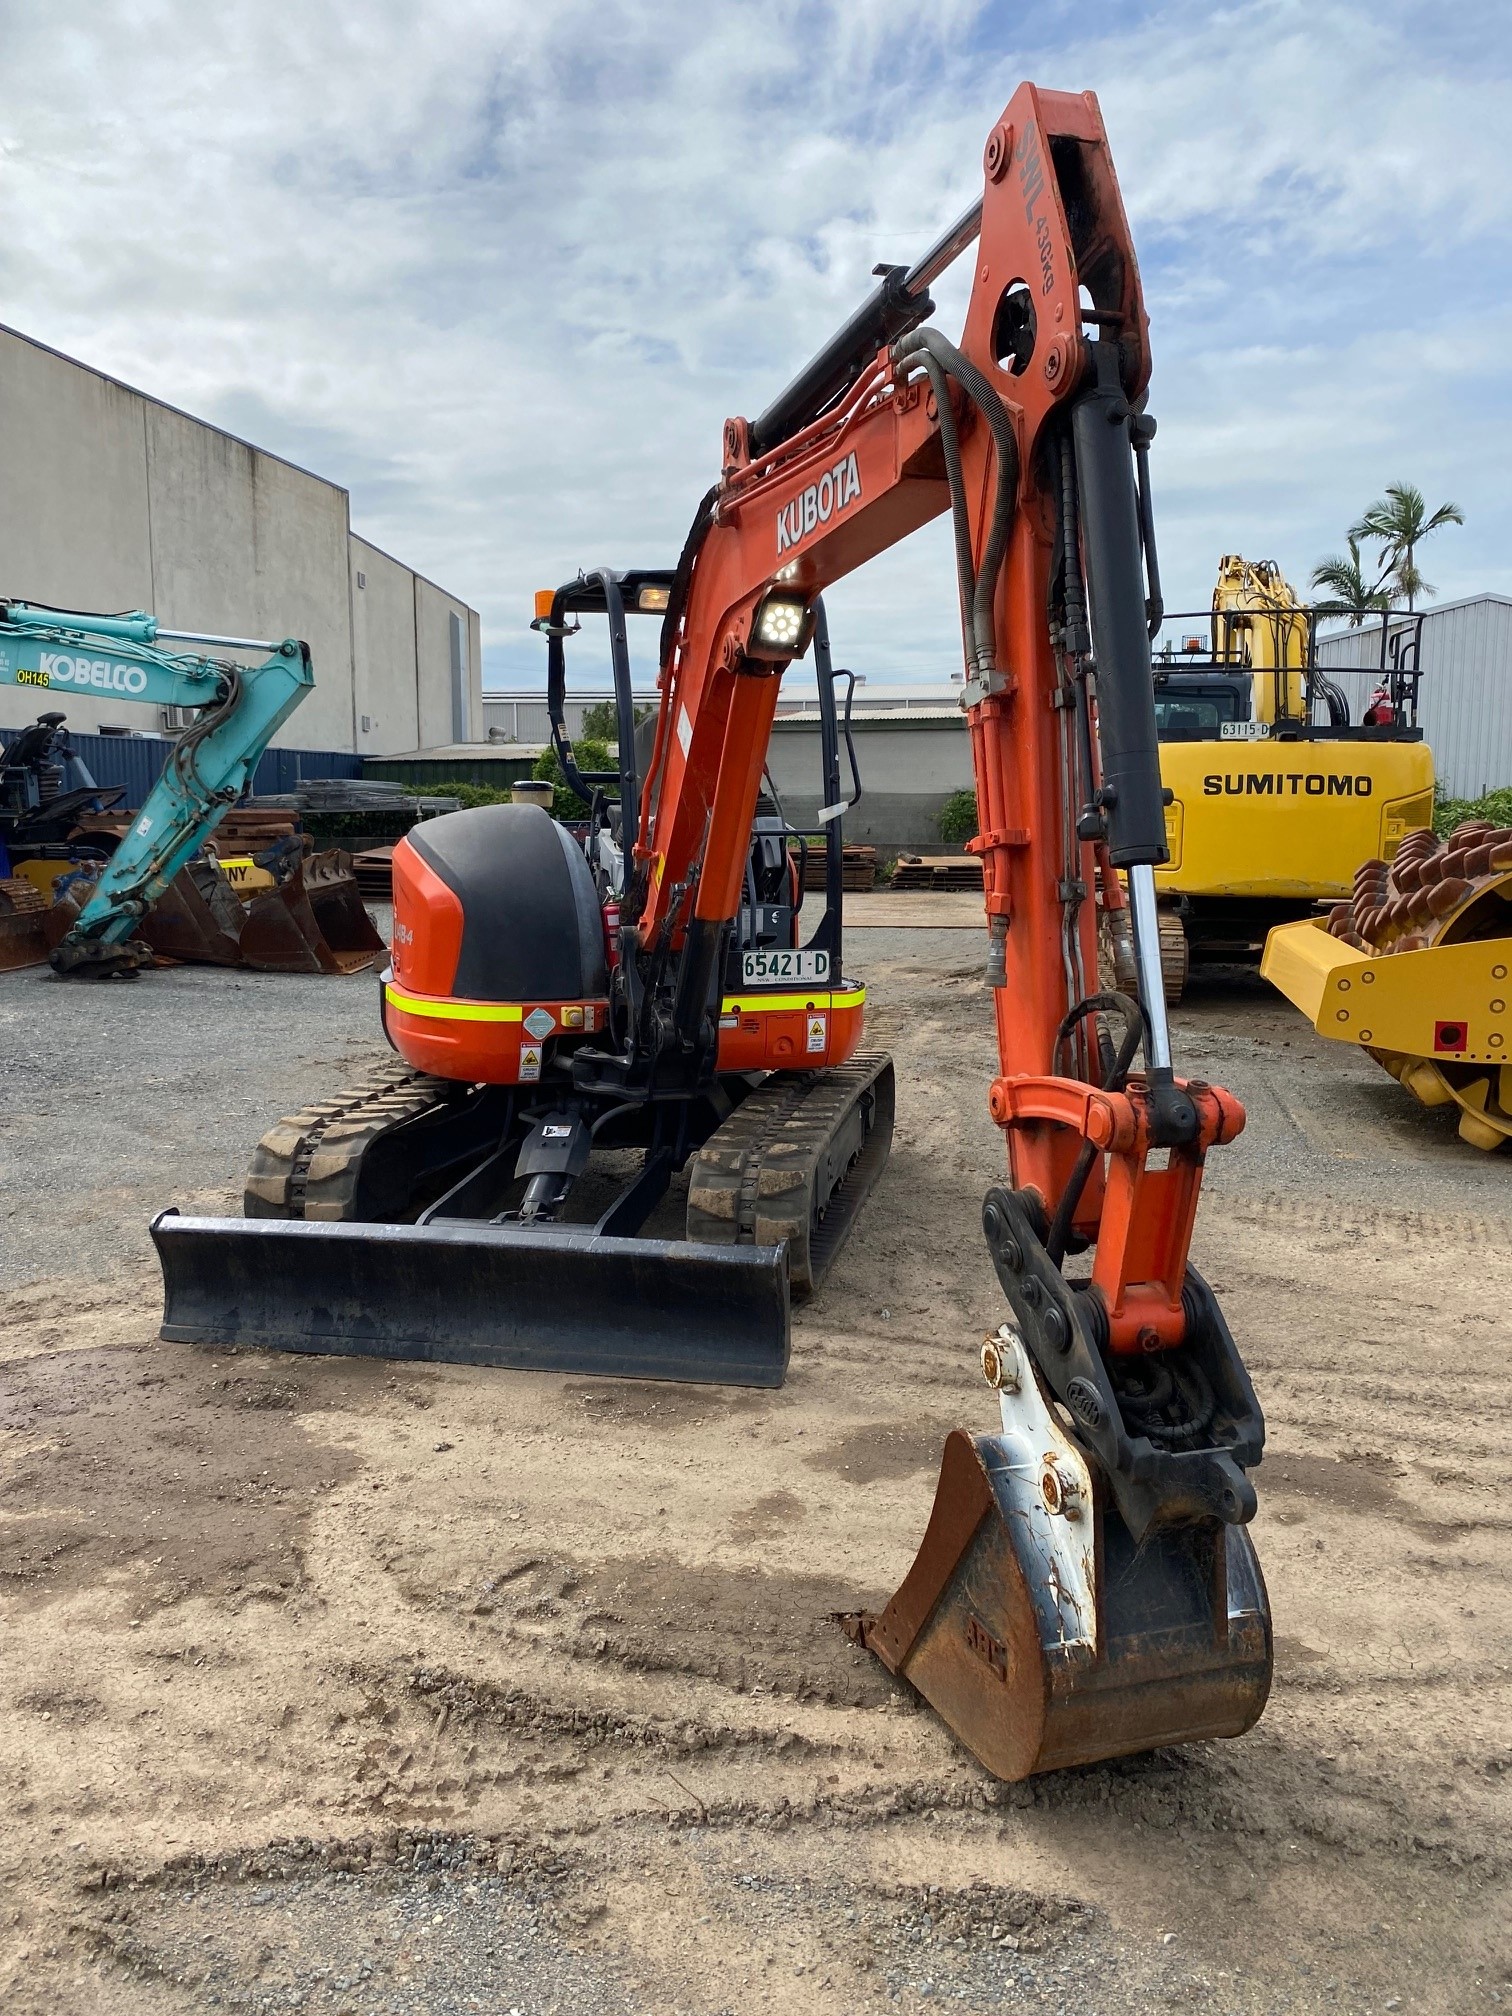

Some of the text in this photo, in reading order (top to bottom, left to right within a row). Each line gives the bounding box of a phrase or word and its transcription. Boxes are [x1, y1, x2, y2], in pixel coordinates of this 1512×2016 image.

[1015, 119, 1045, 226] SWL
[776, 449, 862, 556] KUBOTA
[17, 670, 49, 687] OH145
[40, 652, 147, 694] KOBELCO
[1203, 774, 1372, 796] SUMITOMO
[225, 866, 247, 882] NY
